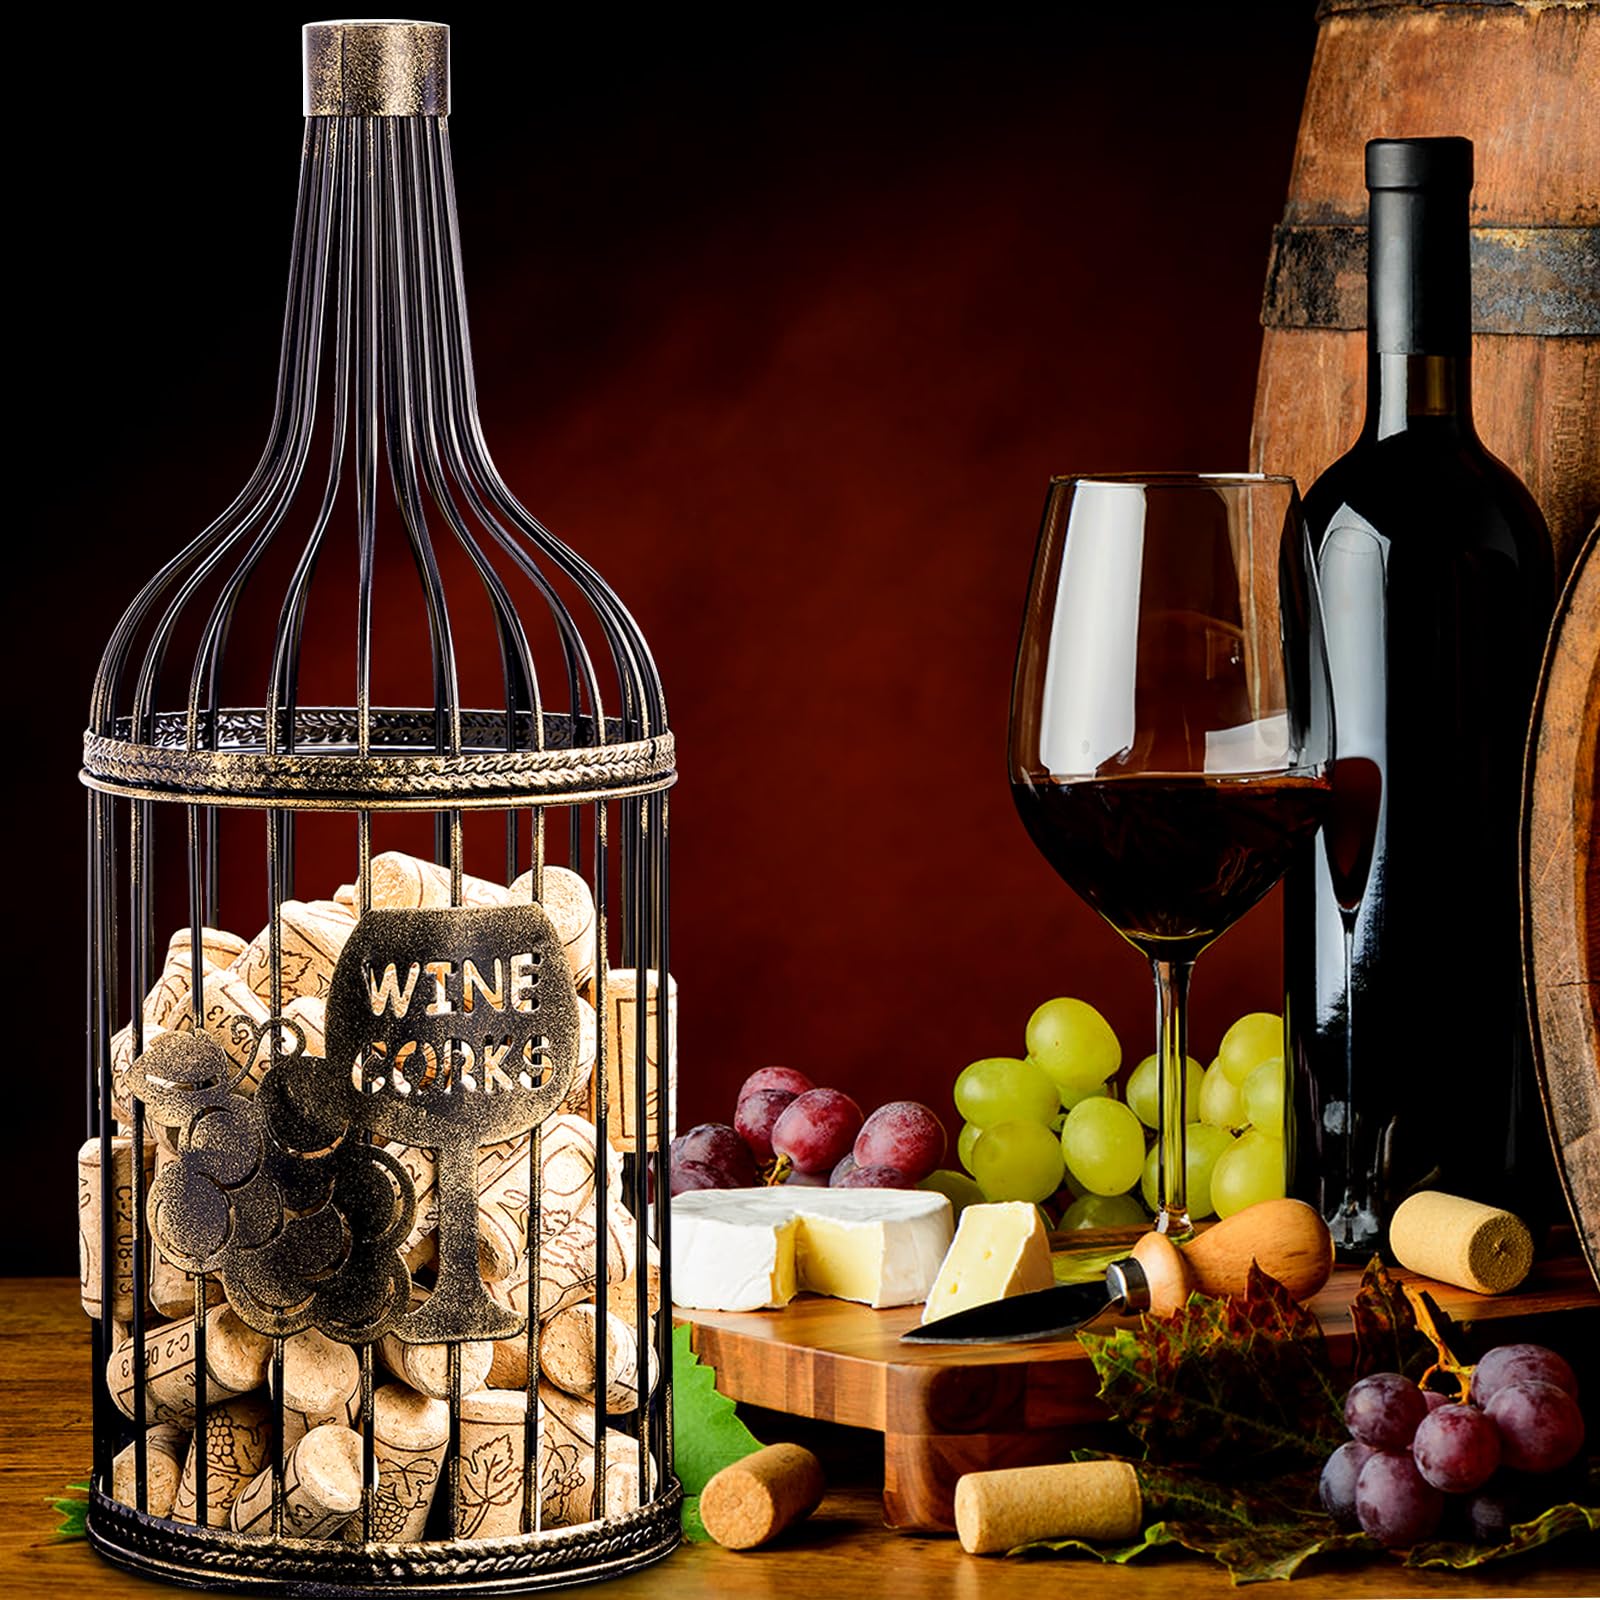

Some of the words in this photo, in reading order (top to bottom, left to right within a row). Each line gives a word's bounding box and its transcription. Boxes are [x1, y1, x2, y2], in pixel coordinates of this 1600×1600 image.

[361, 952, 542, 1018] WINE
[351, 1034, 554, 1096] CORKS
[121, 1346, 160, 1378] 083
[166, 1332, 190, 1359] C-2
